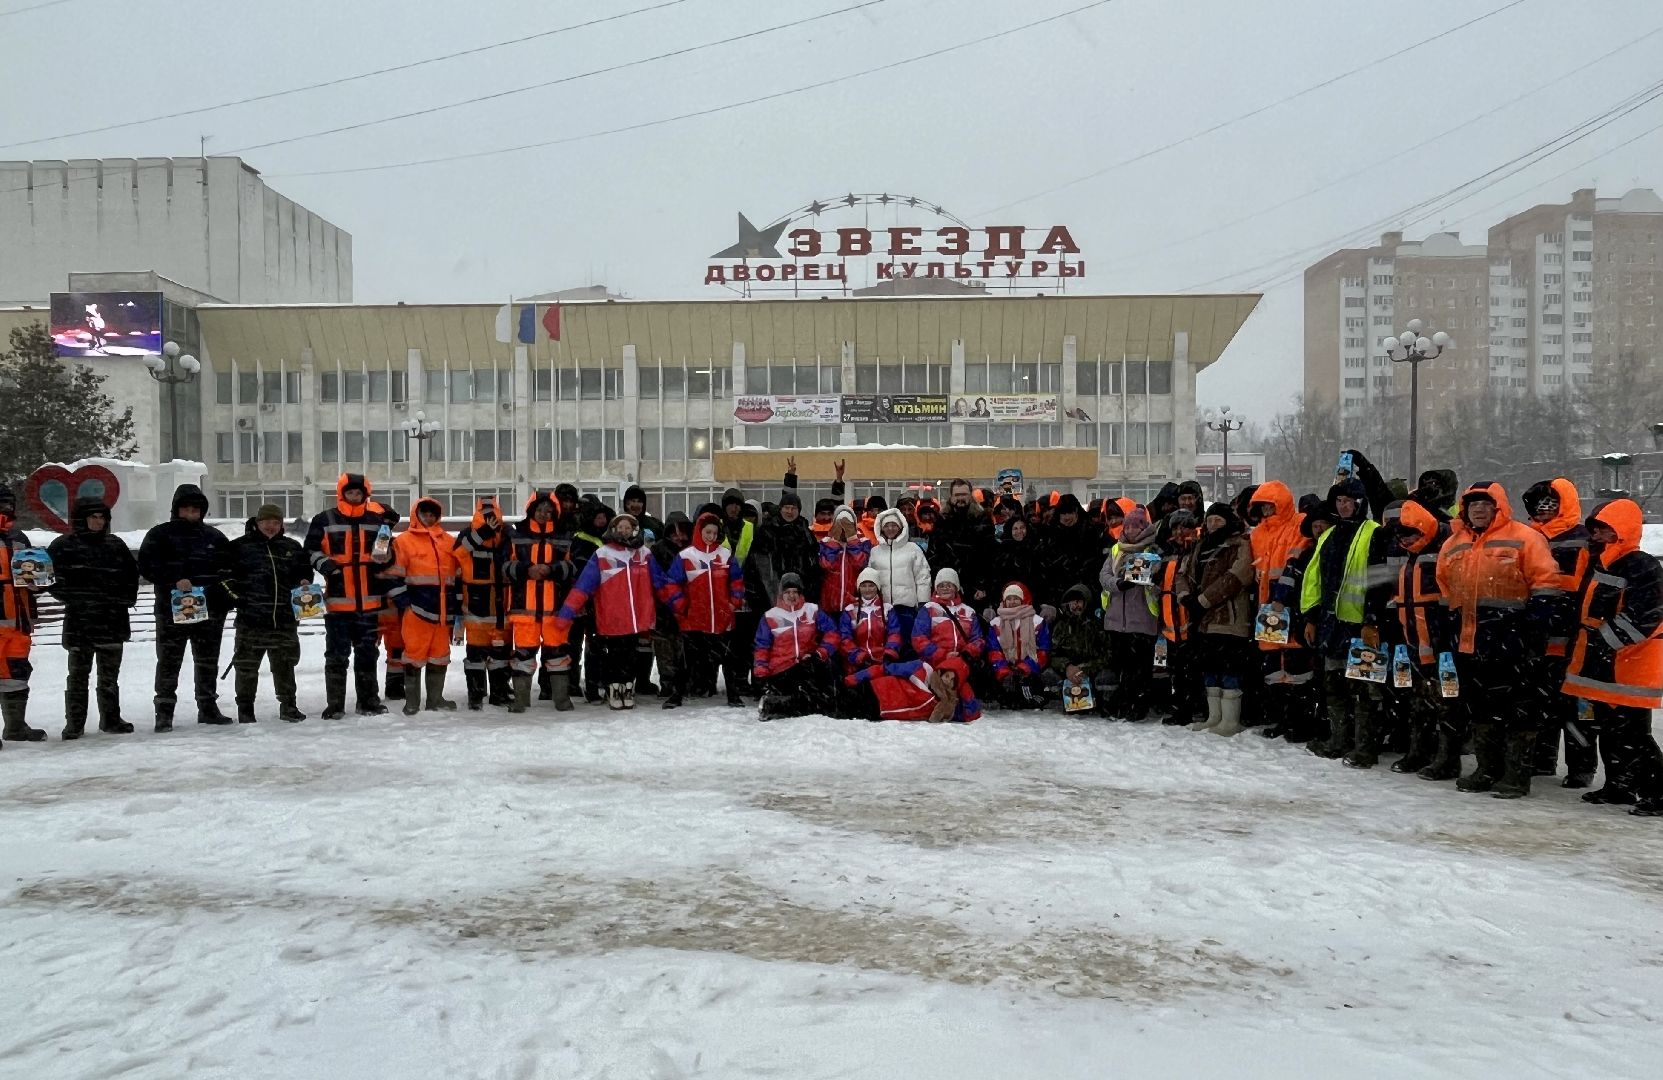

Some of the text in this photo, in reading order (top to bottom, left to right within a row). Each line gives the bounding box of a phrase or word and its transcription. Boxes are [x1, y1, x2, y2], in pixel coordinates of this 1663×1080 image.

[787, 225, 1081, 260] ЗВЕЗДА
[704, 260, 1085, 285] ДВОРЕЦ КУЛЬТУРЫ
[893, 404, 947, 414] КУЗЬМИН
